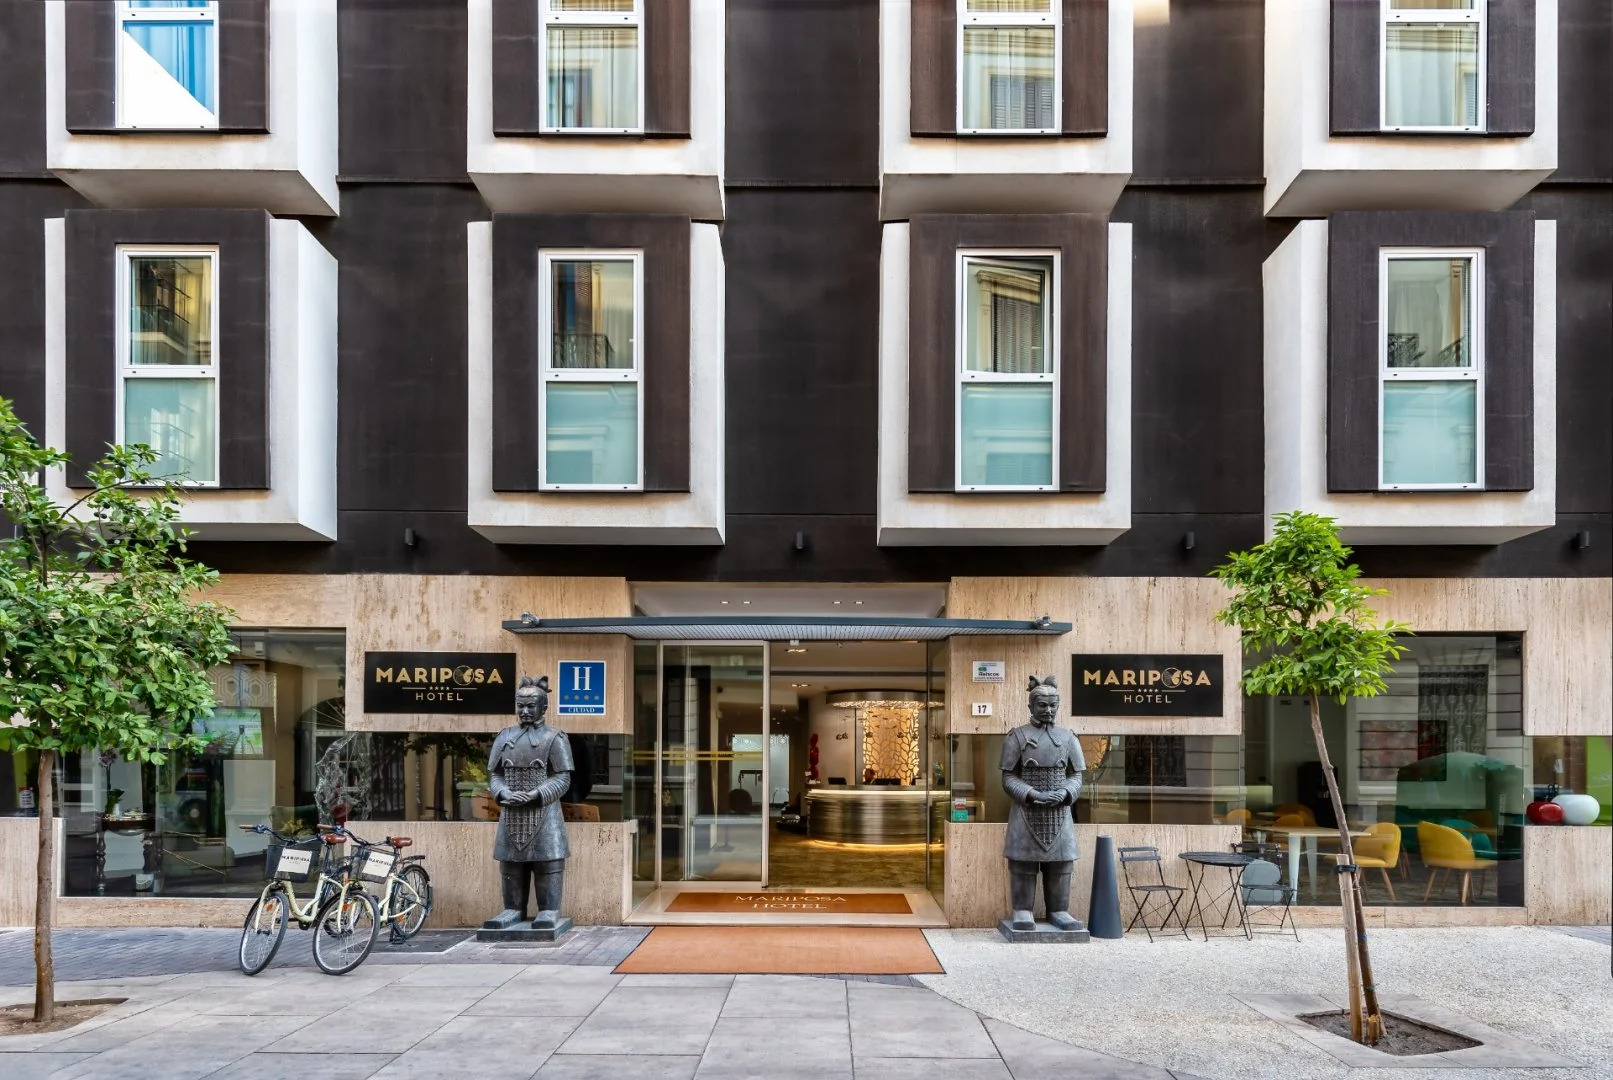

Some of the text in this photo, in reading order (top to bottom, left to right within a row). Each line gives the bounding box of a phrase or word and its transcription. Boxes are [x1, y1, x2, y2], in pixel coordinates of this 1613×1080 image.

[375, 665, 503, 685] MARIPOSA
[571, 666, 592, 691] H
[1083, 667, 1212, 688] MARIPOSA
[415, 692, 463, 701] HOTEL
[1124, 694, 1172, 704] HOTEL
[977, 704, 987, 714] 17
